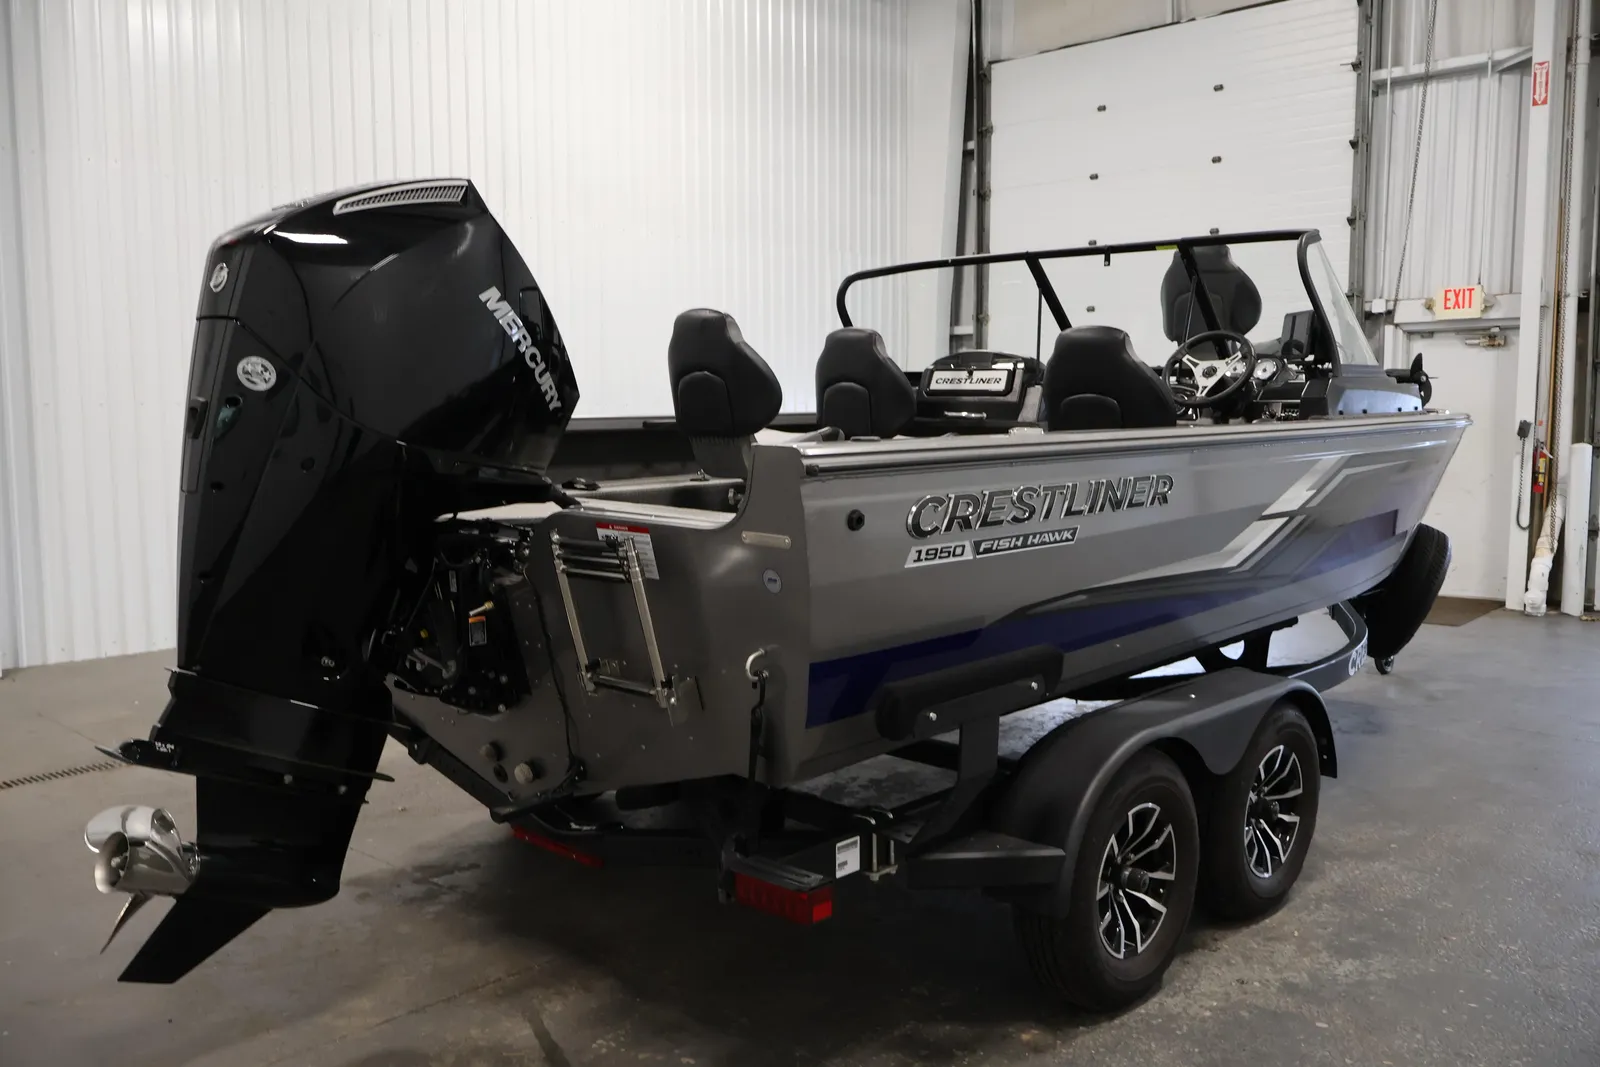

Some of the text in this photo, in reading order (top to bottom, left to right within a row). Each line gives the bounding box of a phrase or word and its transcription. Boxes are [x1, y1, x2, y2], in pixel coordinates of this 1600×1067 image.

[1444, 288, 1475, 310] EXIT
[478, 285, 562, 411] MERCURY
[935, 377, 1002, 385] CRESTLINER
[905, 473, 1175, 540] CRESTLINER
[913, 529, 1074, 563] 1950 FISH HAWK
